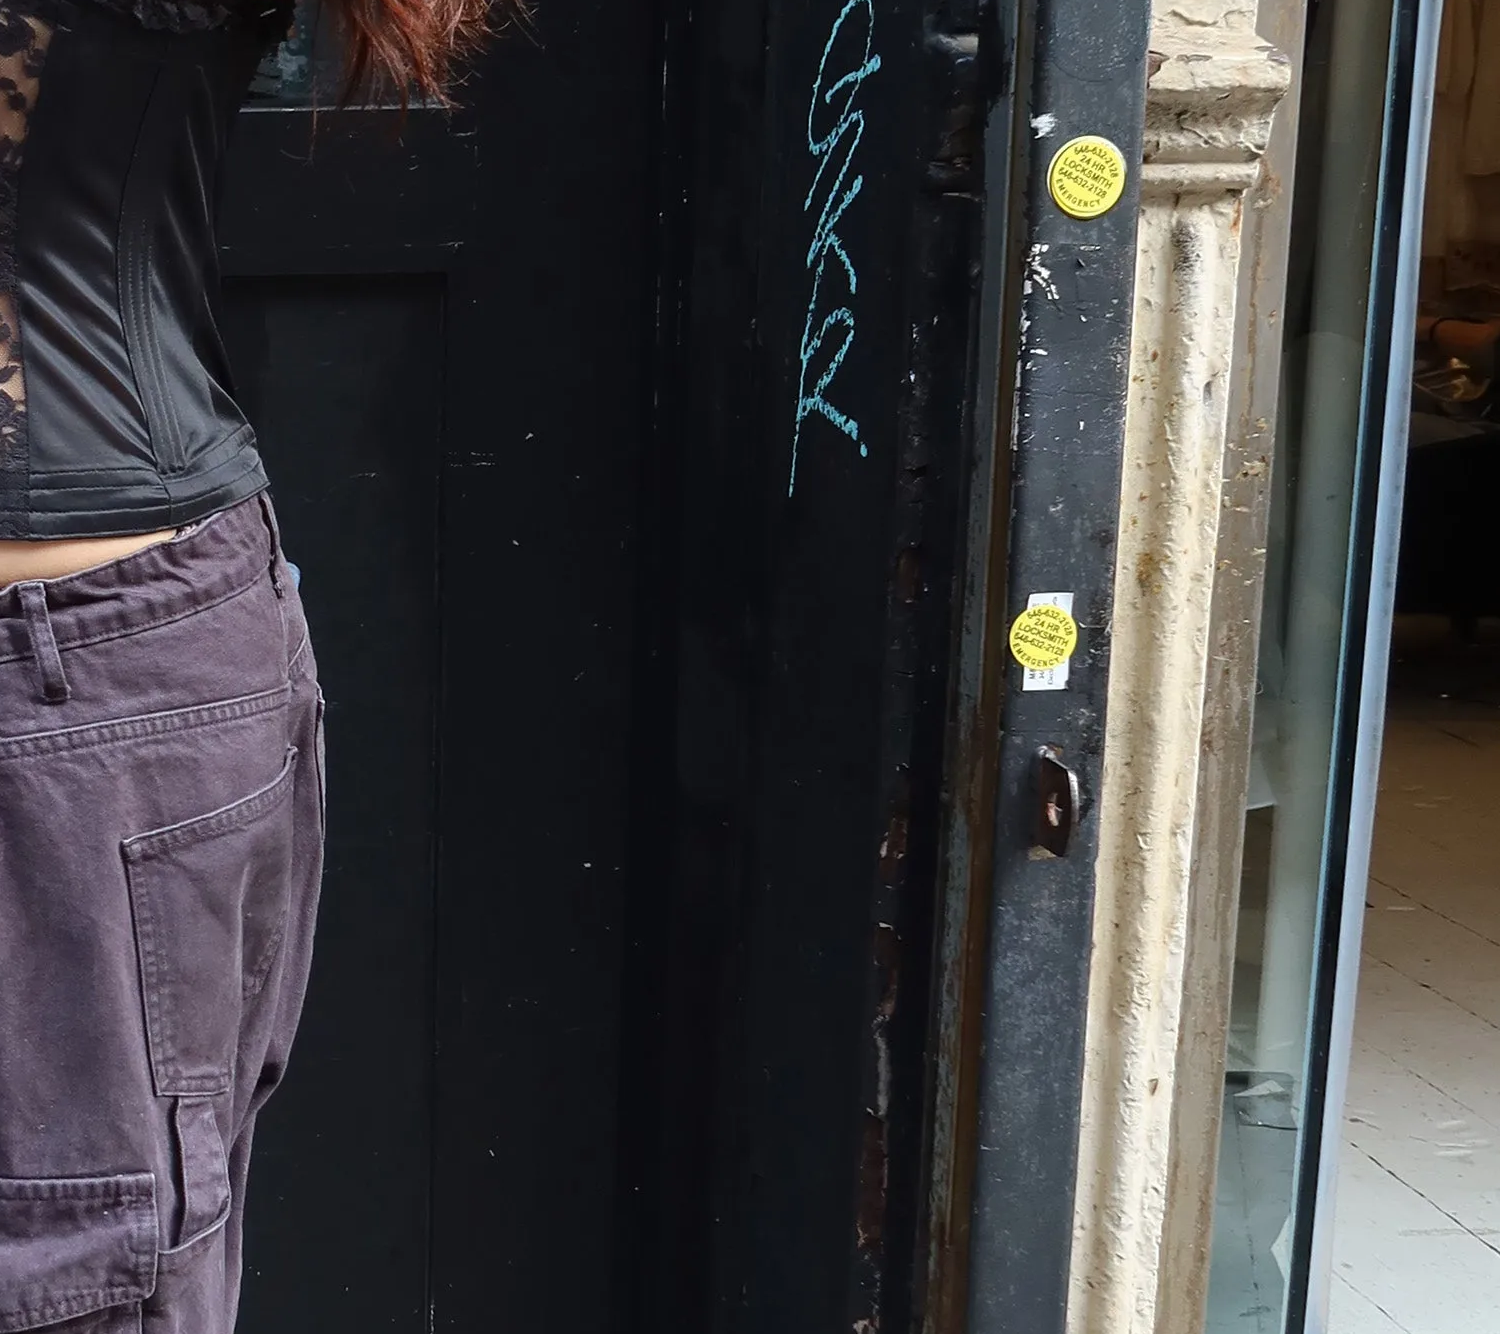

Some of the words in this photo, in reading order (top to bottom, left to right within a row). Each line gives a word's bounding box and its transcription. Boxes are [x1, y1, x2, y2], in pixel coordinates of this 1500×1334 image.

[1063, 157, 1113, 189] LOCKSMITH
[1074, 145, 1119, 178] 646-632-2128
[1079, 154, 1091, 167] 24
[1091, 161, 1106, 174] HR
[1056, 178, 1101, 208] EMERGENCY
[1058, 167, 1107, 199] 646-632-2128
[1018, 622, 1069, 647] LOCKSMITH
[1026, 608, 1074, 636] 646-632-2128
[1035, 618, 1045, 628] 24
[1047, 623, 1061, 634] HR
[1013, 642, 1060, 667] EMERGENCY
[1014, 631, 1065, 657] 646-632-2128
